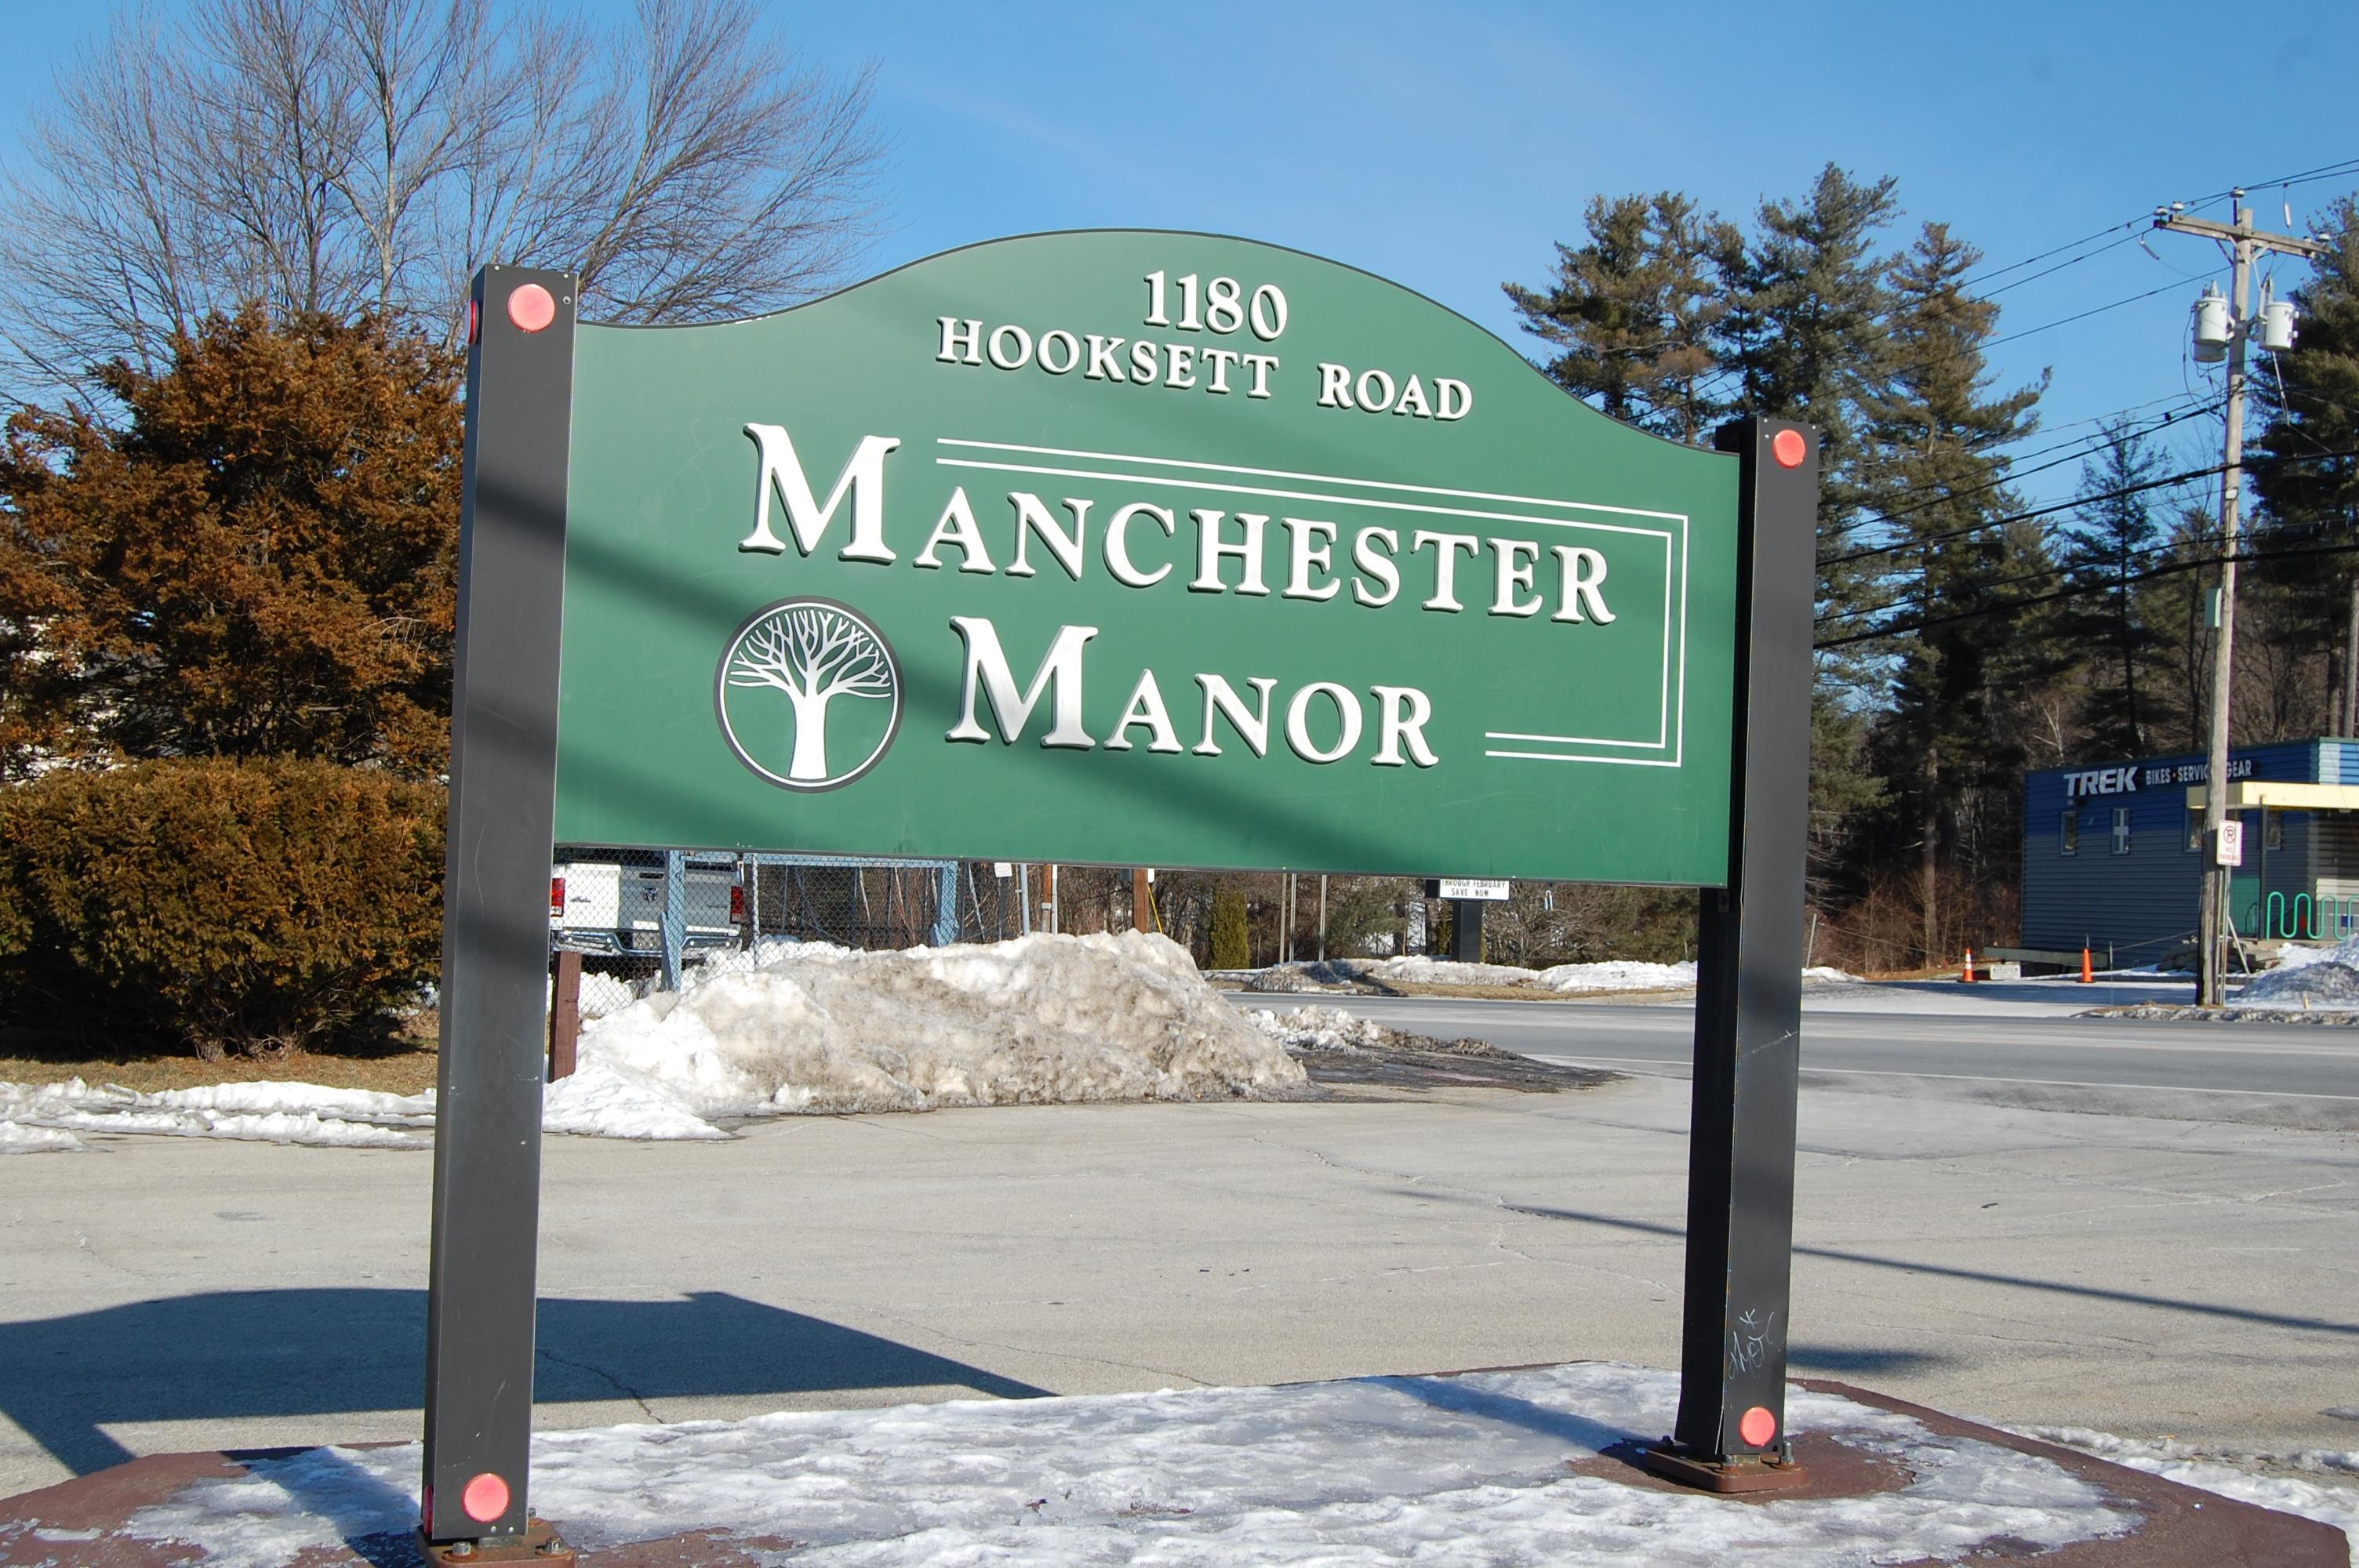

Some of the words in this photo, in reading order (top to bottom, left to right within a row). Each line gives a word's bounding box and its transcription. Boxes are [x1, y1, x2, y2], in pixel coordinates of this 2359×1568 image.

[1144, 270, 1289, 340] 1180
[936, 316, 1280, 398] HOOKSETT
[1318, 362, 1473, 422] ROAD
[738, 422, 1617, 626] MANCHESTER
[946, 615, 1441, 768] MANOR
[2063, 766, 2138, 797] TREK
[2146, 768, 2171, 786] BIKES
[2177, 764, 2208, 782] SERVIC
[2226, 759, 2252, 779] GEAR
[1451, 887, 1468, 896] SAVE
